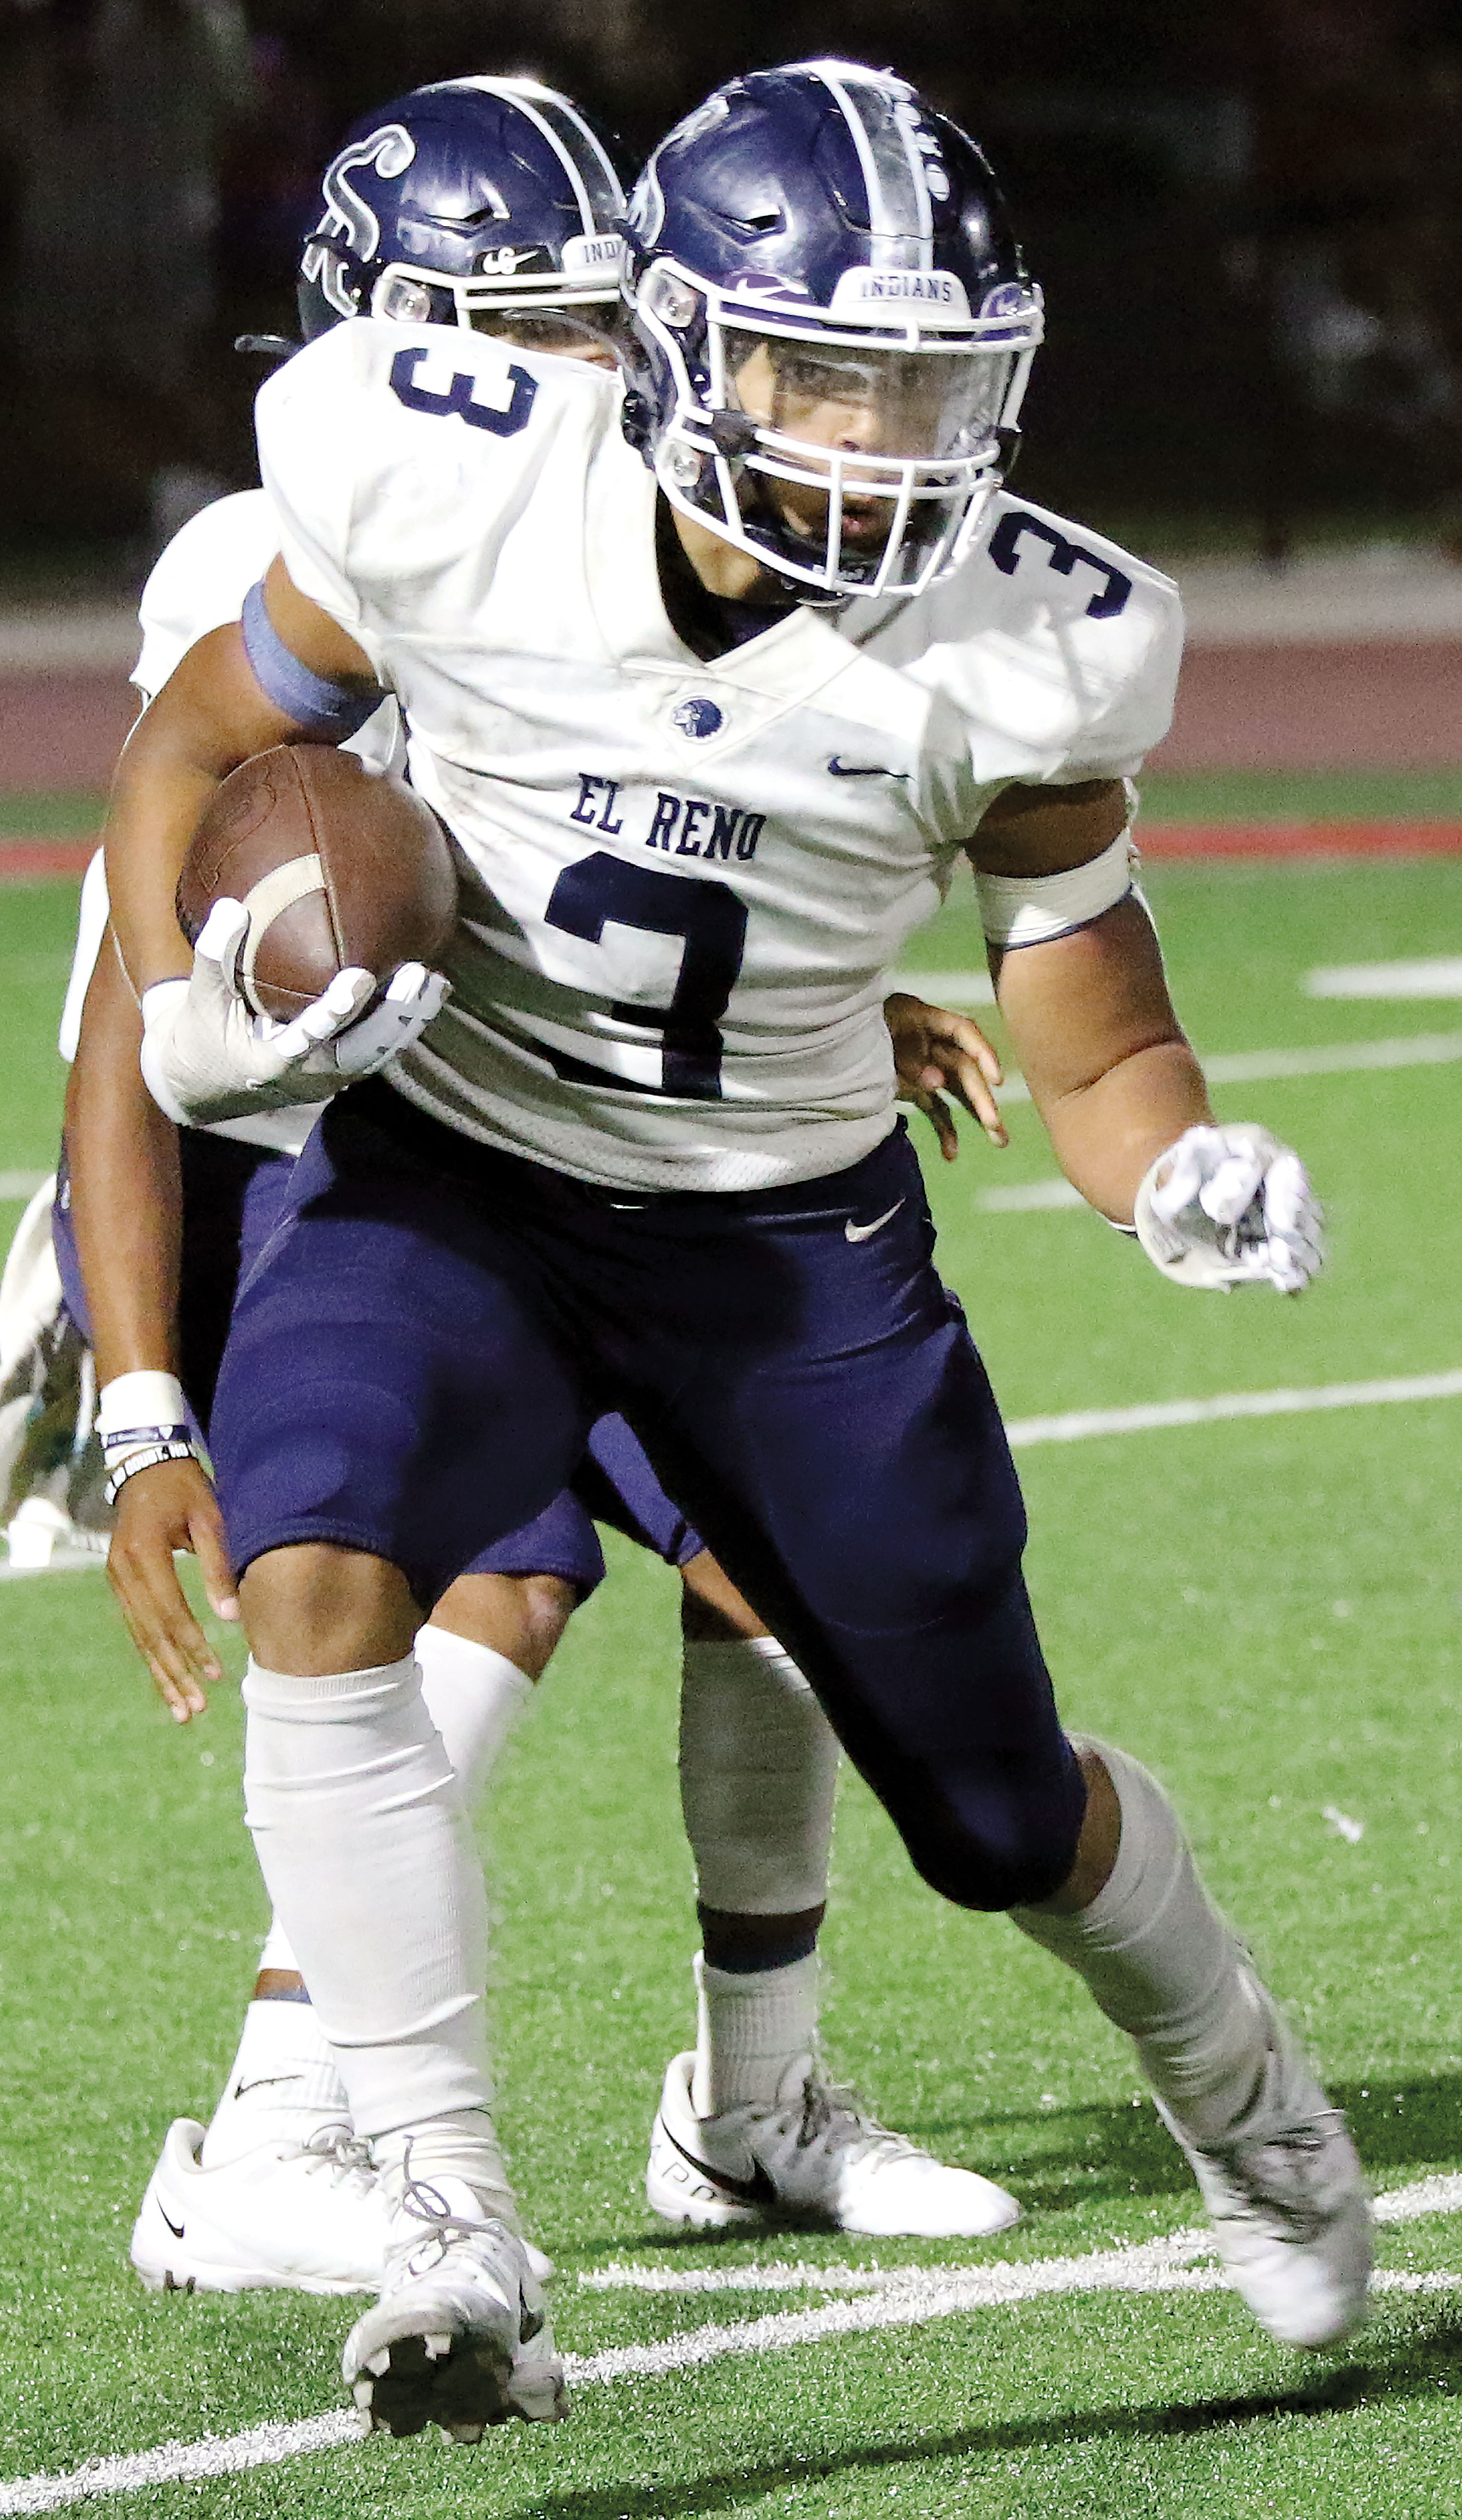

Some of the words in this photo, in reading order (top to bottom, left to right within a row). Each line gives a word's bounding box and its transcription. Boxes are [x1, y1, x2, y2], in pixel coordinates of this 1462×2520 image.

[861, 276, 951, 302] INDIANS
[390, 347, 539, 438] 3
[988, 512, 1133, 619] 3
[570, 772, 624, 835] EL
[645, 792, 767, 861] RENO
[544, 850, 749, 1099] 3
